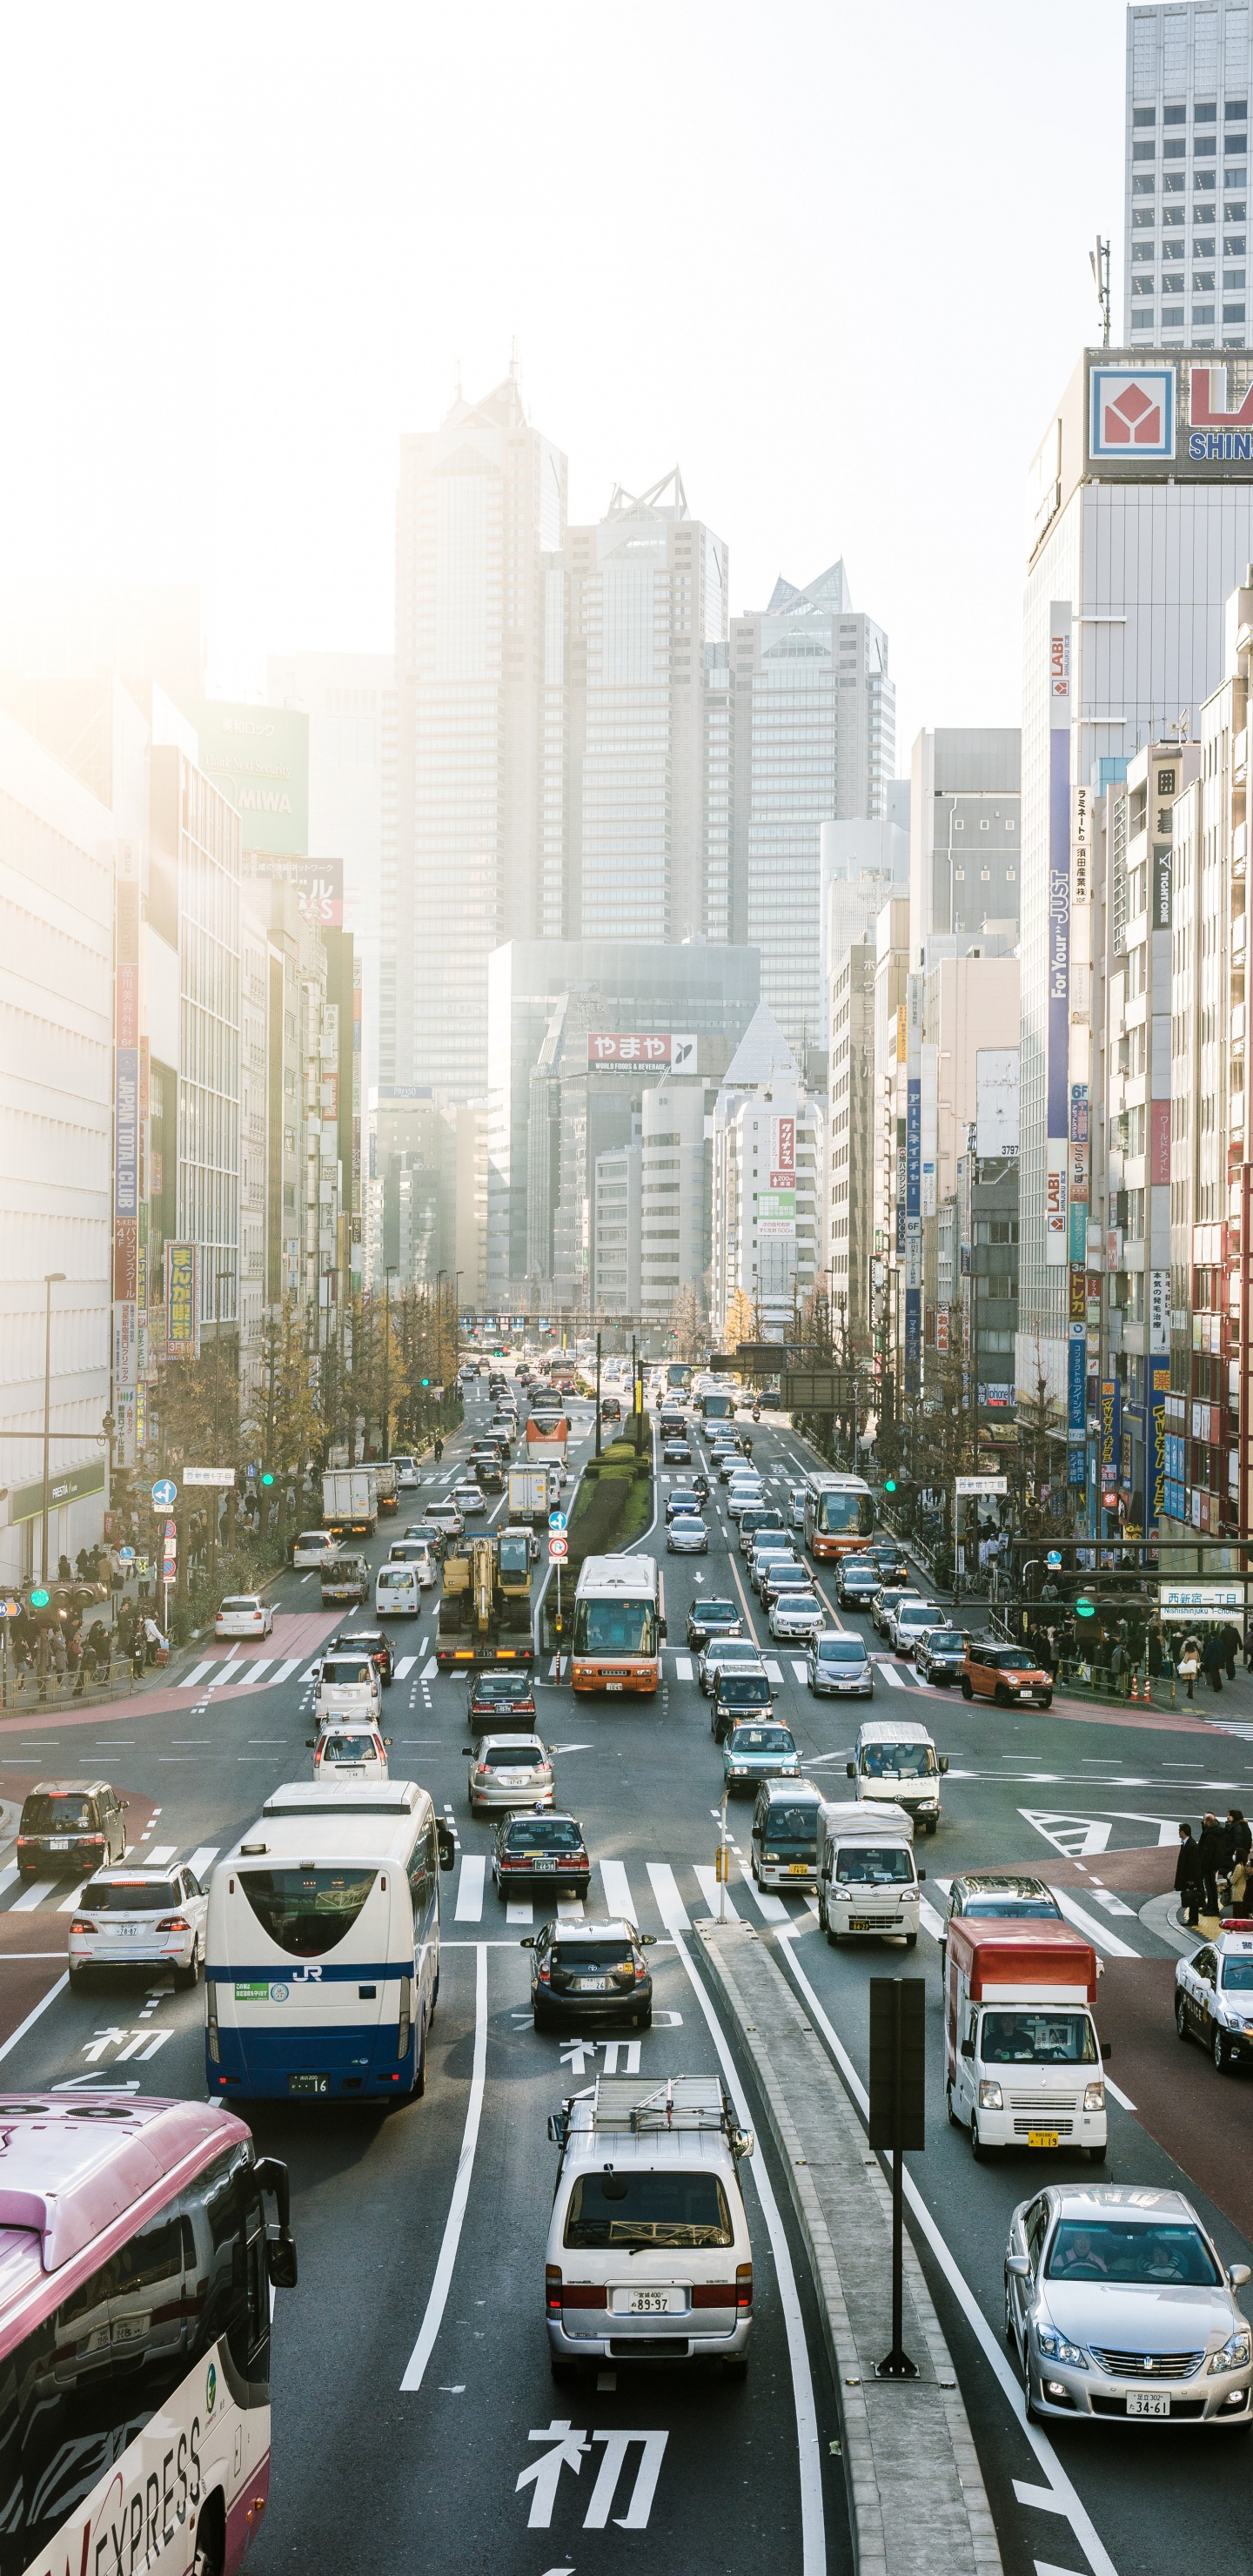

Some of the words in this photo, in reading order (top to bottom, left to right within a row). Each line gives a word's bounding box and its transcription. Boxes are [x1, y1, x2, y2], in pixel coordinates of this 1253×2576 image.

[1188, 432, 1253, 461] SHIN
[1051, 636, 1064, 677] LABI
[222, 718, 274, 737] 美和ロック
[204, 753, 230, 768] Think
[233, 758, 253, 771] Next
[255, 760, 291, 779] Security
[237, 788, 292, 814] MIWA
[1077, 789, 1086, 842] ラミネートの
[1049, 869, 1069, 924] JUST
[1160, 871, 1169, 923] TIGHTONE
[1051, 935, 1067, 966] Your
[1051, 967, 1067, 998] For
[122, 966, 132, 1036] 品川美容外科
[594, 1036, 666, 1059] やまや
[118, 1076, 135, 1124] JAPAN
[393, 1086, 416, 1096] PRESSO
[1071, 1084, 1088, 1099] 6F
[118, 1127, 135, 1169] TOTAL
[781, 1124, 793, 1165] クリナップ
[908, 1093, 920, 1196] アートネイチャー
[1002, 1145, 1019, 1155] 3797
[1160, 1116, 1169, 1174] ワールドメイト
[117, 1171, 135, 1209] CLUB
[1048, 1173, 1060, 1212] LABI
[117, 1228, 124, 1248] 4F
[125, 1227, 137, 1298] パソコンスクール
[1071, 1263, 1086, 1272] 3F
[171, 1249, 191, 1340] まんが喫茶
[1072, 1274, 1084, 1312] トレカ
[1152, 1271, 1162, 1329] 本気の発毛治療
[121, 1305, 130, 1382] 望星新宿南口クリニック
[978, 1383, 986, 1405] 新宿
[988, 1388, 1008, 1399] iphone
[1102, 1383, 1114, 1394] 薬
[1155, 1372, 1169, 1389] 薬
[1102, 1397, 1115, 1463] マツモトキヨシ
[52, 1485, 68, 1499] PRESTIA
[1163, 1607, 1209, 1616] Nishishinjuku
[1168, 1592, 1237, 1606] 西新宿一丁目
[292, 1965, 322, 1982] JR
[1183, 1994, 1202, 2022] POLICE
[82, 2028, 175, 2061] 初
[559, 2038, 642, 2075] 初
[314, 2080, 326, 2092] 16
[638, 2298, 667, 2311] 89-97
[1136, 2401, 1166, 2414] 34-61
[514, 2419, 670, 2529] 初
